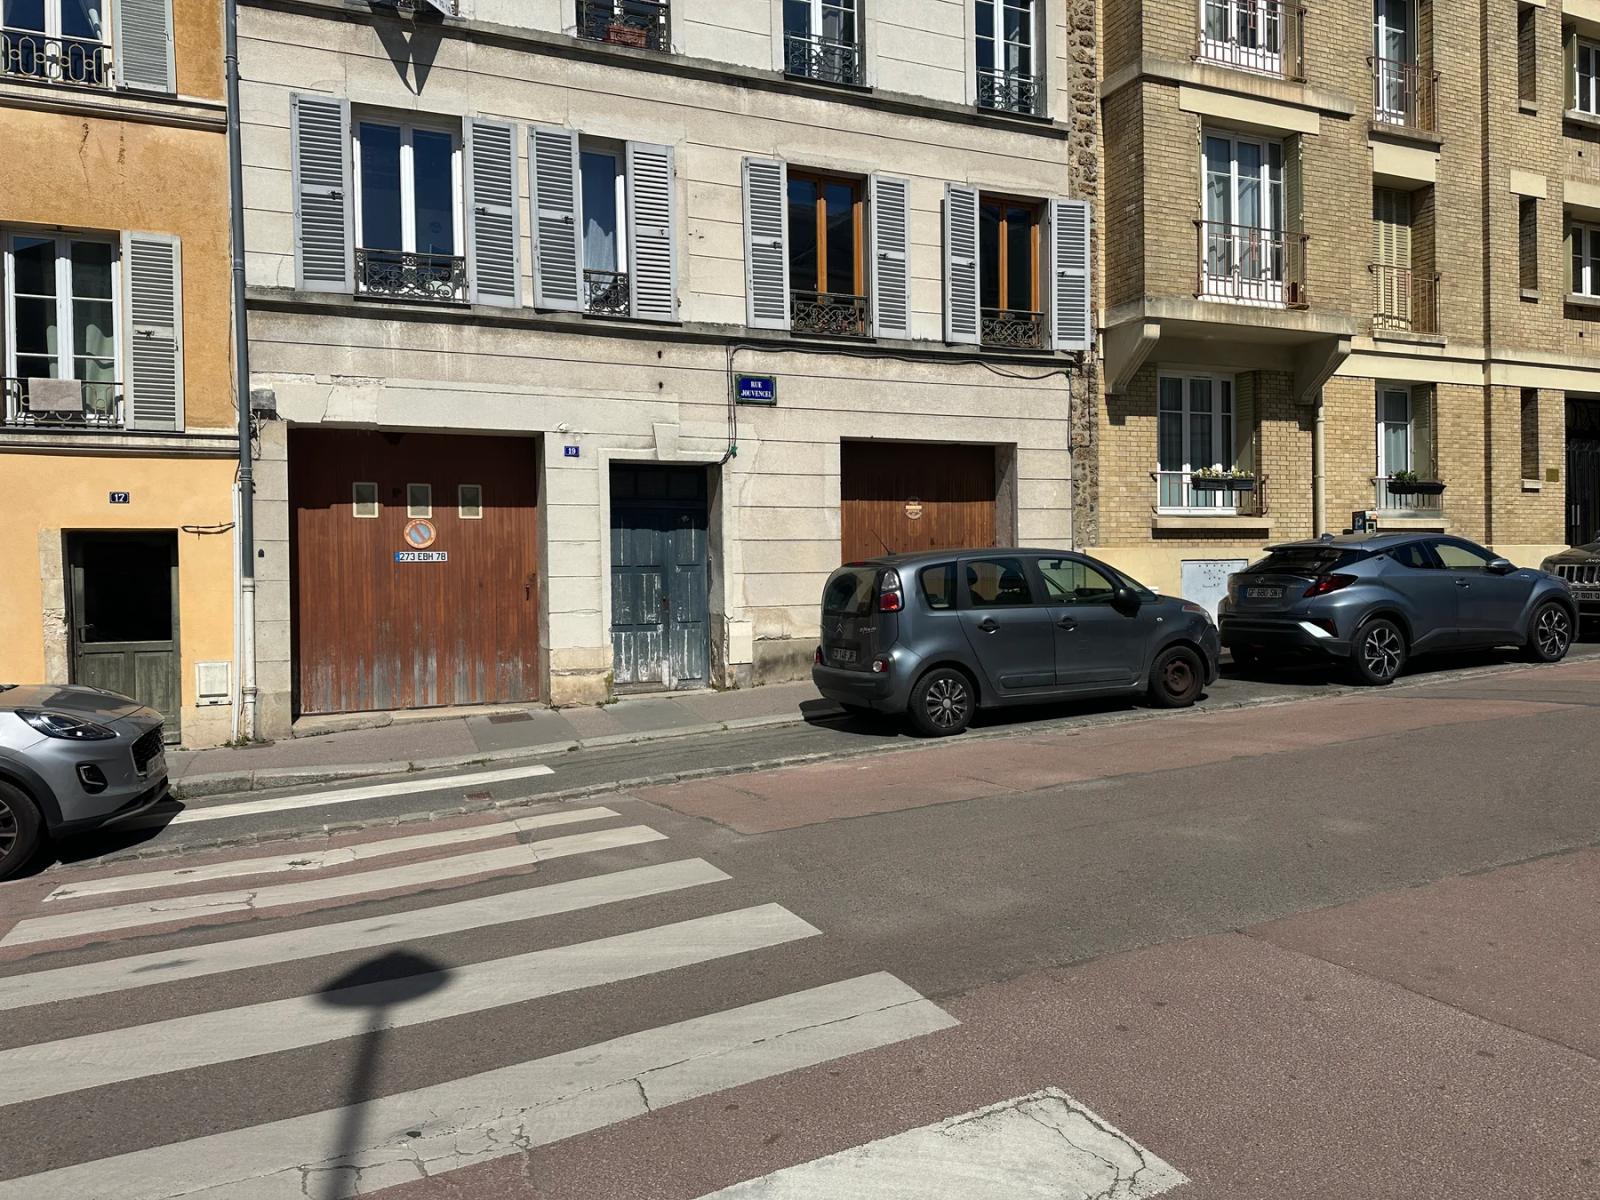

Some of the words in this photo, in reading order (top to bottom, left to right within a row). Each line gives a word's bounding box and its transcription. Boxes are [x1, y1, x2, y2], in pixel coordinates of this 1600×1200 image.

[750, 381, 762, 389] RUE
[114, 493, 125, 502] 17
[400, 553, 415, 561] 273
[418, 553, 433, 561] EBH
[436, 553, 446, 561] 78
